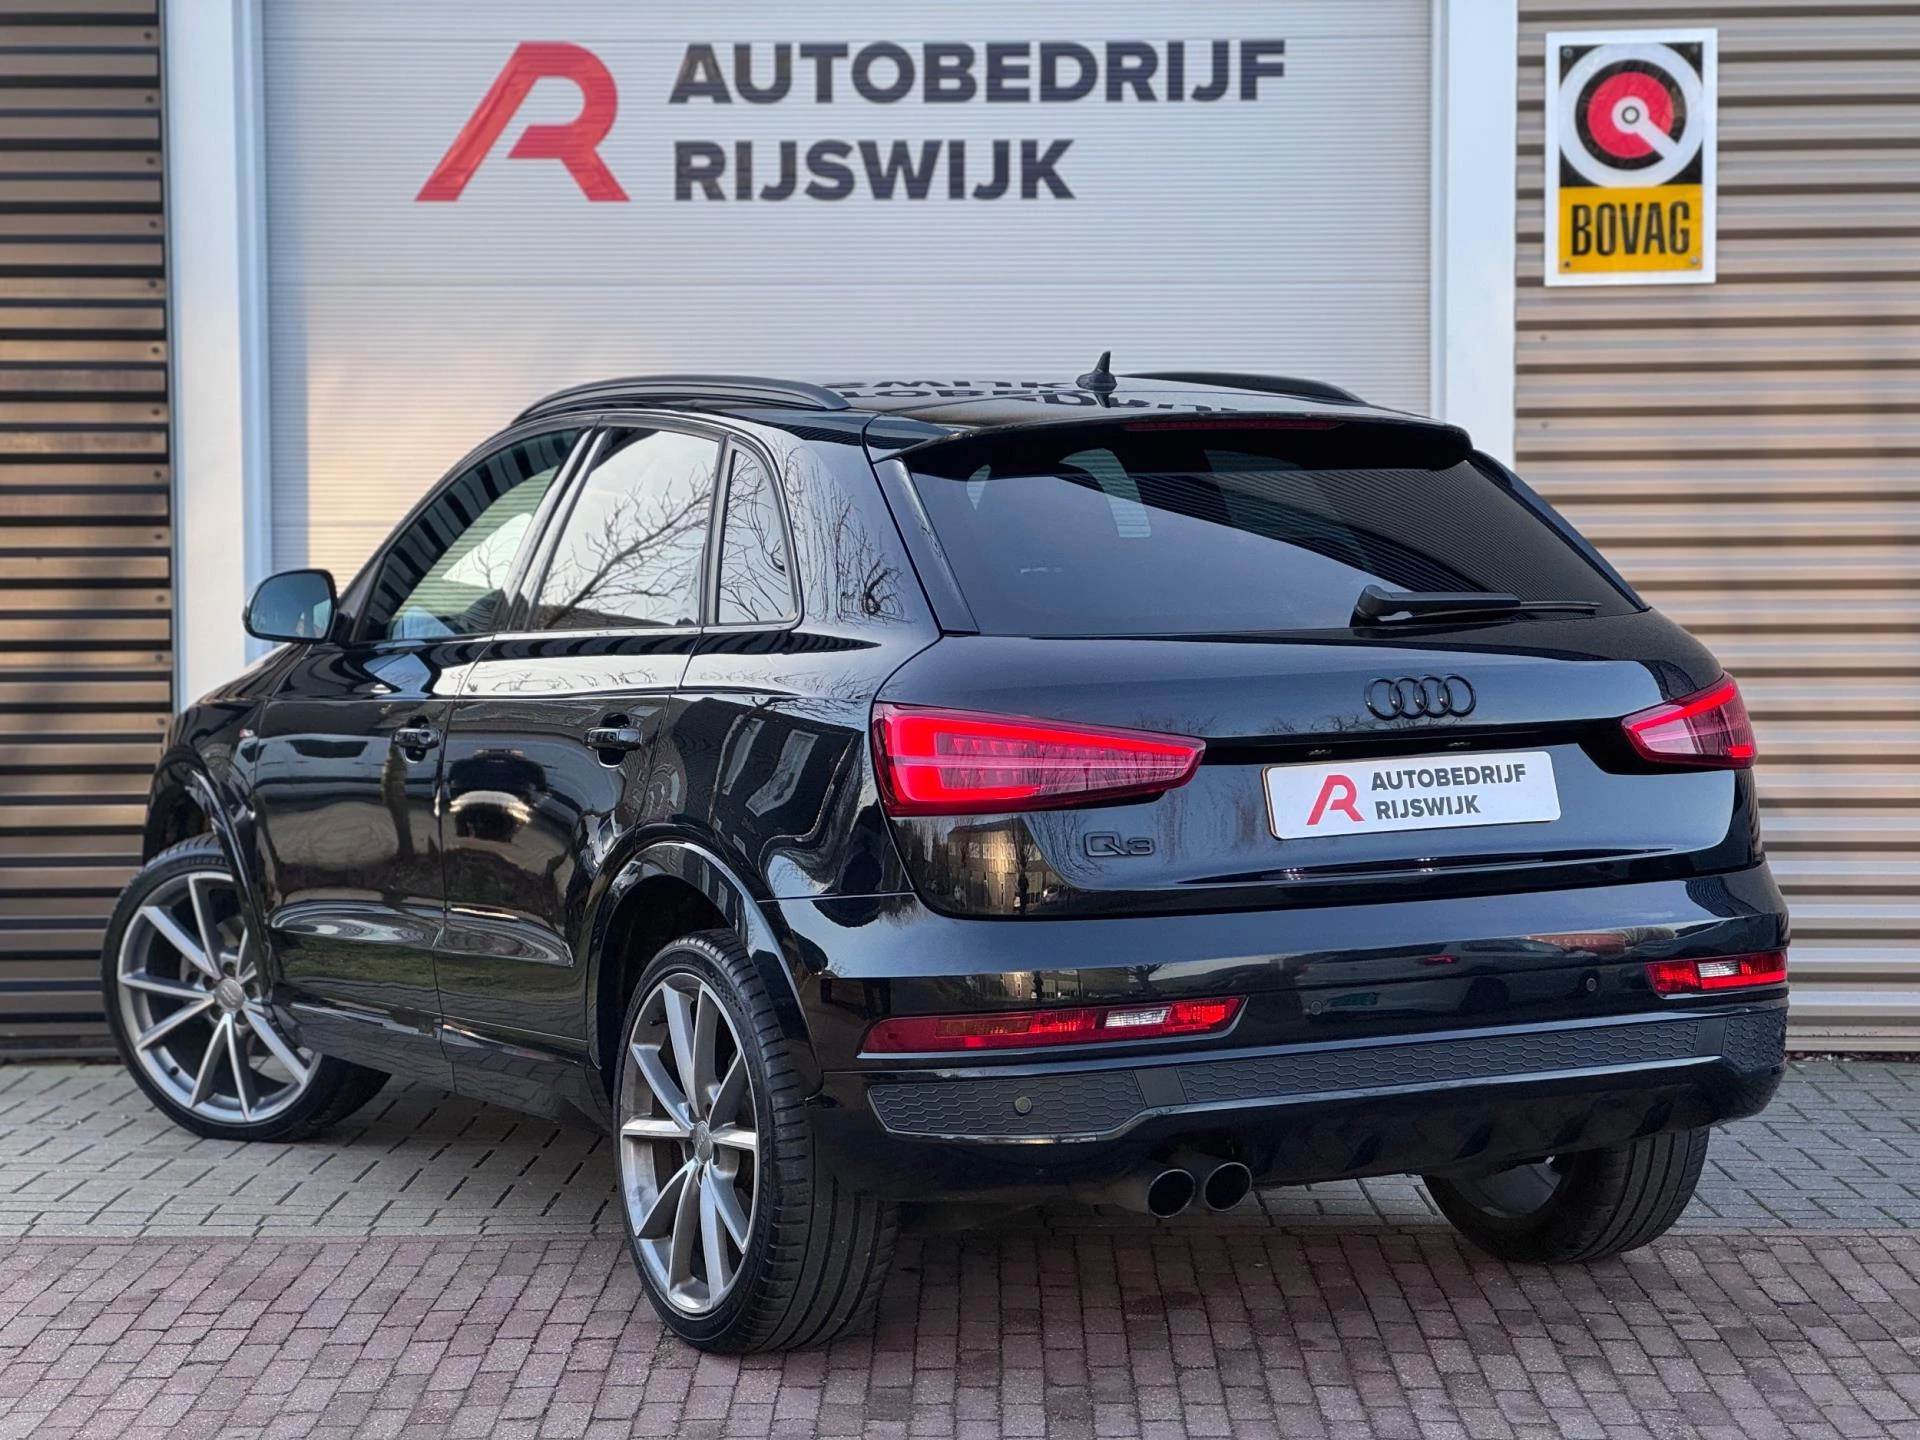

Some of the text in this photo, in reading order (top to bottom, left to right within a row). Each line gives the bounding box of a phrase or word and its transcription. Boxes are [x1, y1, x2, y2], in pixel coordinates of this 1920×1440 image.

[669, 39, 1286, 104] AUTOBEDRIJF
[675, 139, 1077, 201] RIJSWIJK
[1571, 201, 1690, 256] BOVAG
[1371, 763, 1527, 792] AUTOBEDRIJF
[1376, 795, 1480, 820] RIJSWIJK
[1083, 831, 1155, 857] Q3
